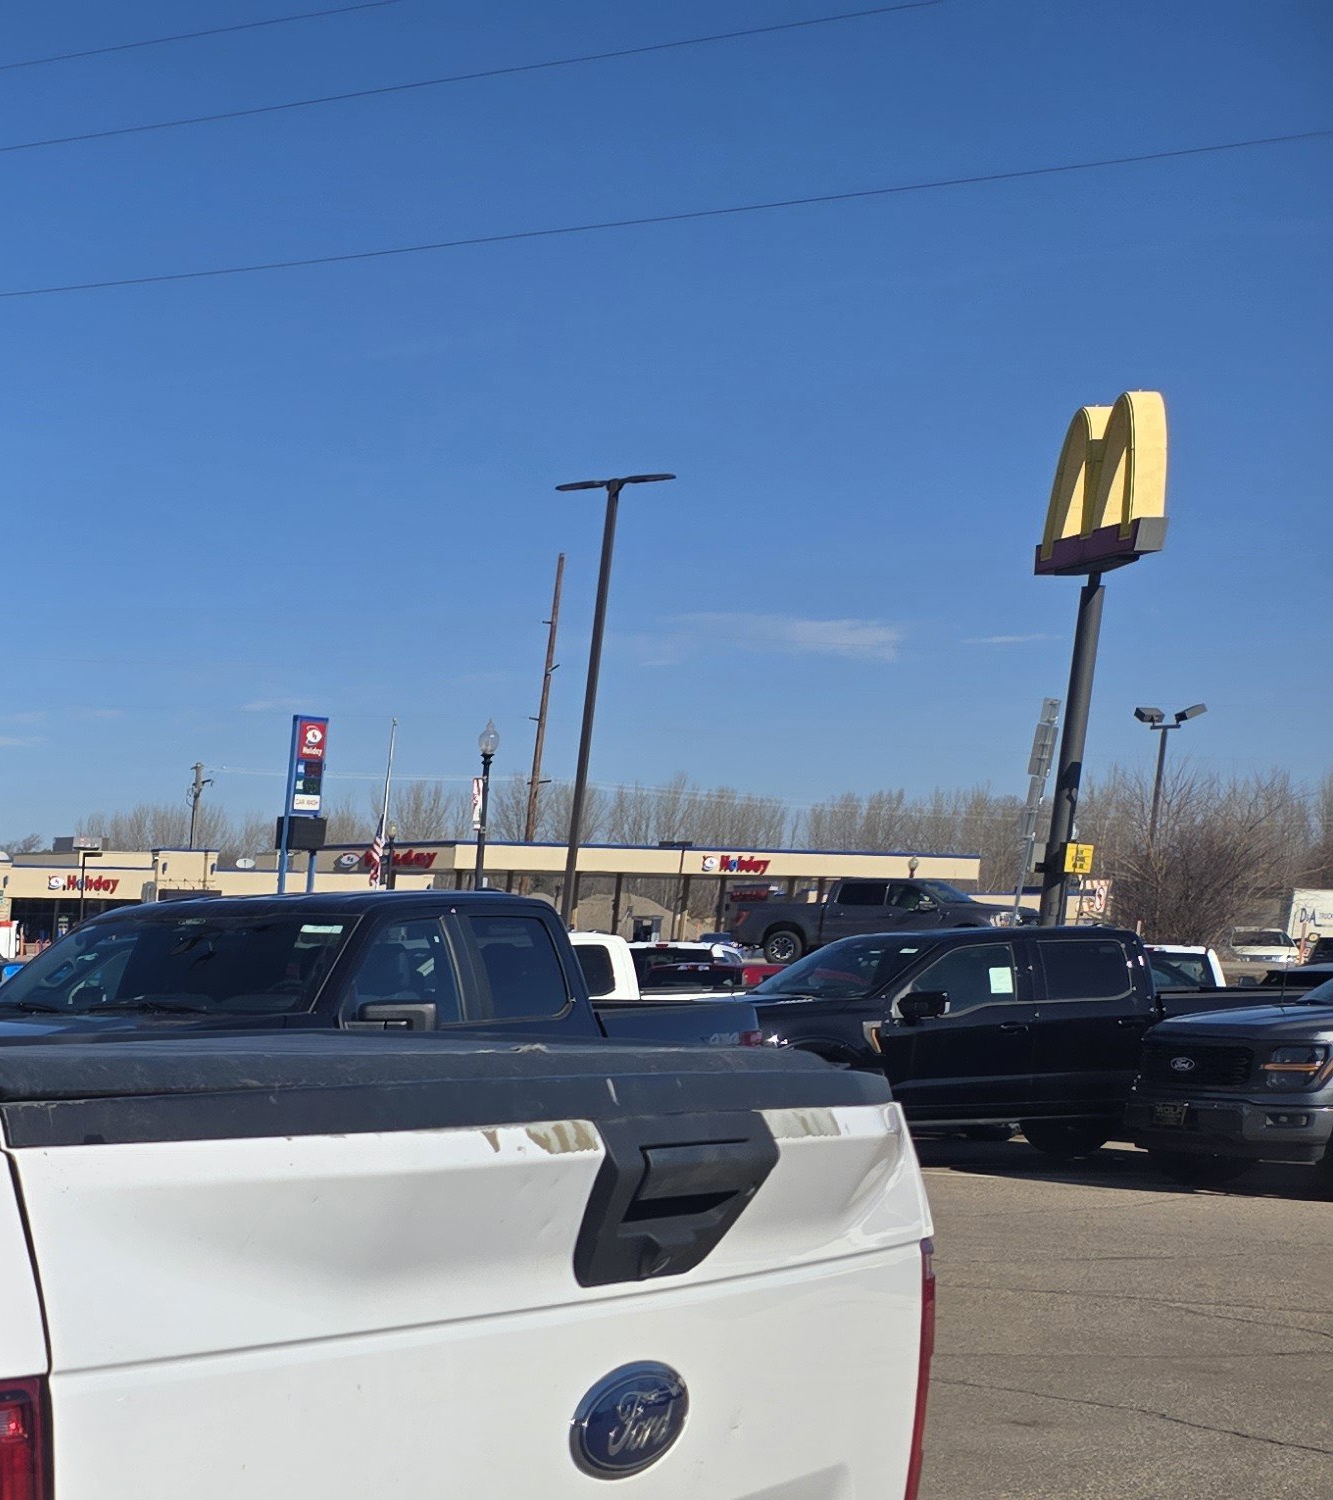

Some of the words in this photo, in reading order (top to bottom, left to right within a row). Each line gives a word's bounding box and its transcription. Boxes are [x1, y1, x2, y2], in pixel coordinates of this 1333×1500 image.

[719, 854, 771, 876] Holiday
[66, 874, 120, 895] Holiday
[608, 1384, 683, 1456] Ford
